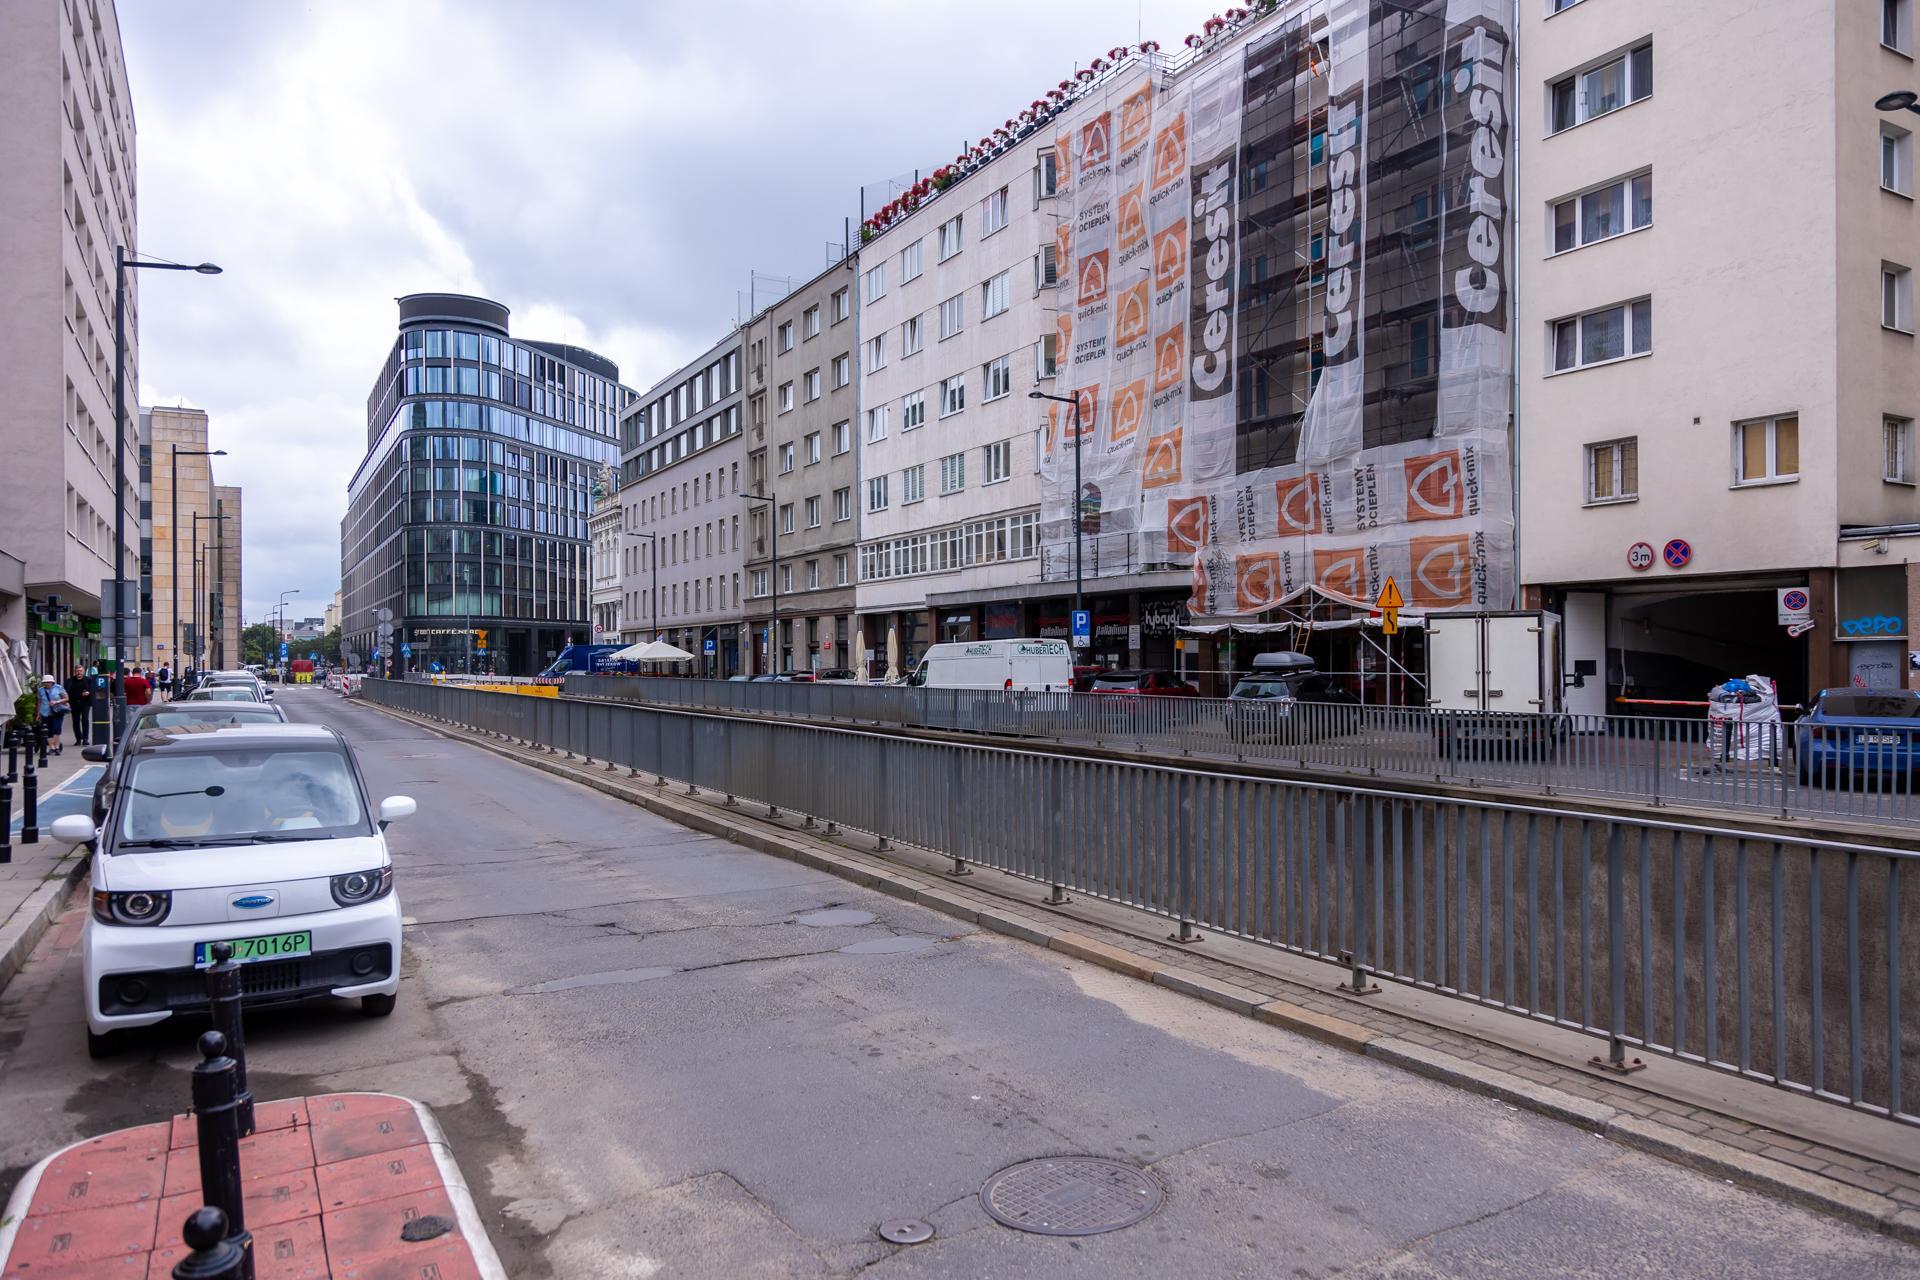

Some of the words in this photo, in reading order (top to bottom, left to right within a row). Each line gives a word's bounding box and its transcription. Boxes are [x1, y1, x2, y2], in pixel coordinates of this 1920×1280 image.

[1079, 165, 1111, 185] quick-mix
[1454, 26, 1503, 313] Ceresit
[1079, 200, 1111, 221] SYSTEMY
[1118, 236, 1149, 266] quick-mix
[1192, 161, 1230, 392] Ceresit
[1077, 302, 1108, 321] quick-mix
[1076, 335, 1107, 353] SYSTEMY
[1116, 339, 1147, 363] quick-mix
[1153, 385, 1183, 409] quick-mix
[1463, 445, 1480, 517] quick-mix
[1321, 472, 1335, 534] quick-mix
[1354, 467, 1366, 531] SYSTEMY
[1209, 494, 1218, 543] uick-mix
[1472, 531, 1488, 606] quick-mix
[1206, 557, 1218, 615] quick-mix
[1076, 612, 1086, 628] P
[1026, 643, 1065, 655] HUBERTECH
[244, 934, 305, 957] 7016P
